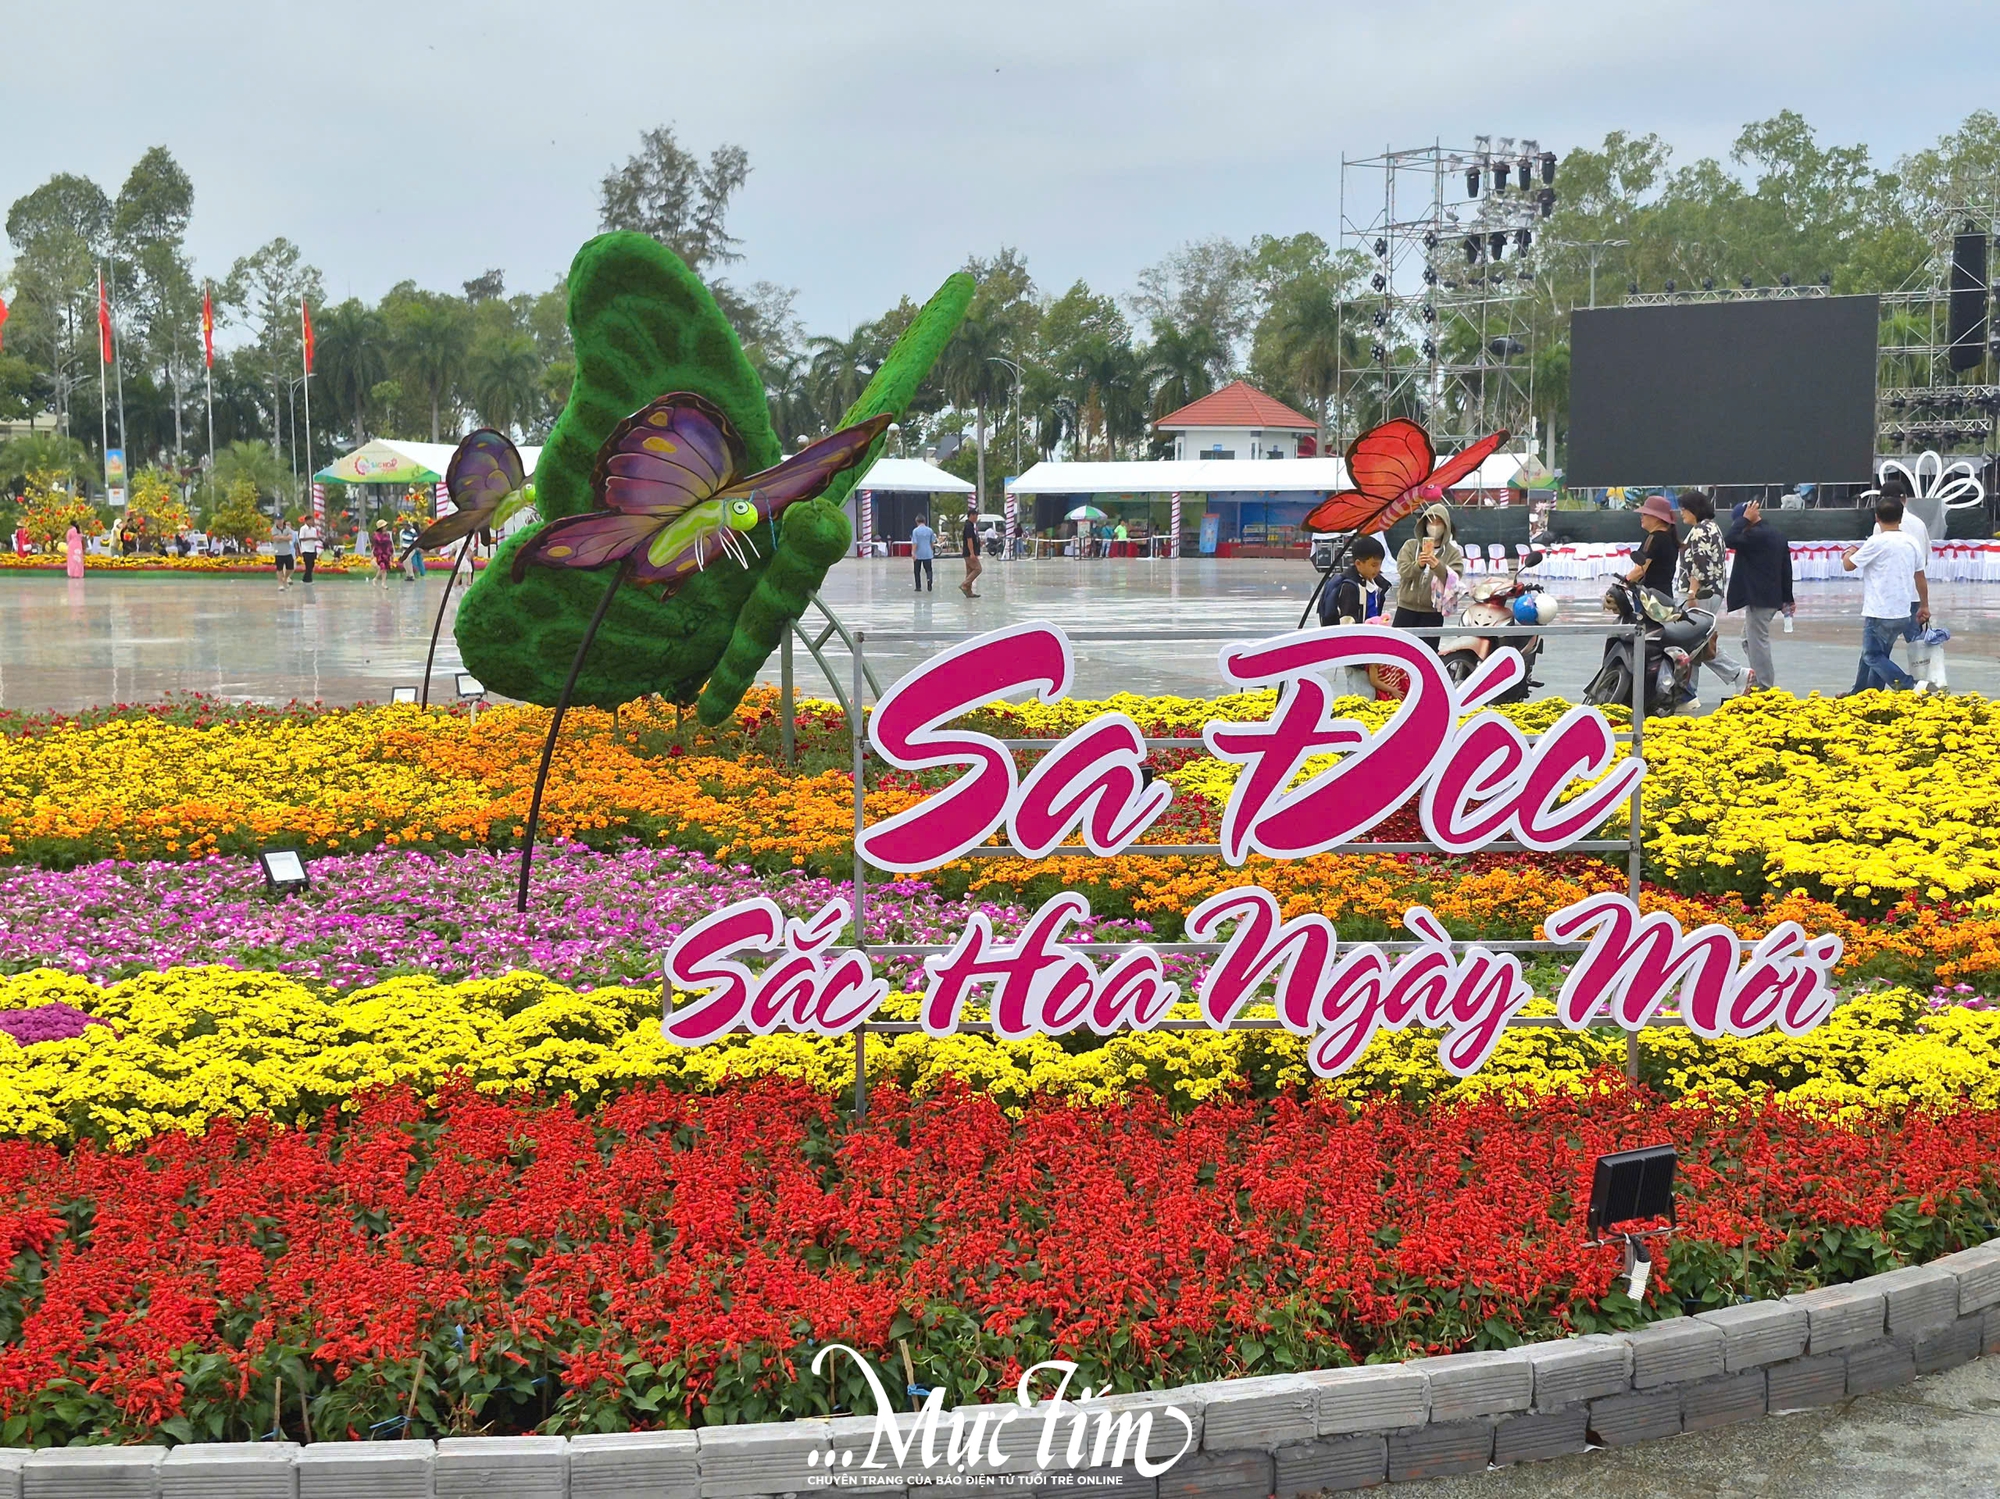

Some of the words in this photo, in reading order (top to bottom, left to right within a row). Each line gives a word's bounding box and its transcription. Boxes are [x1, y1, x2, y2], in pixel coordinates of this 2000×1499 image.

[860, 625, 1170, 868] Sa
[1208, 630, 1640, 860] Đéc
[664, 902, 884, 1042] Sắc
[924, 896, 1176, 1037] Hoa
[1189, 891, 1529, 1075] Ngày
[1550, 897, 1840, 1034] Mới
